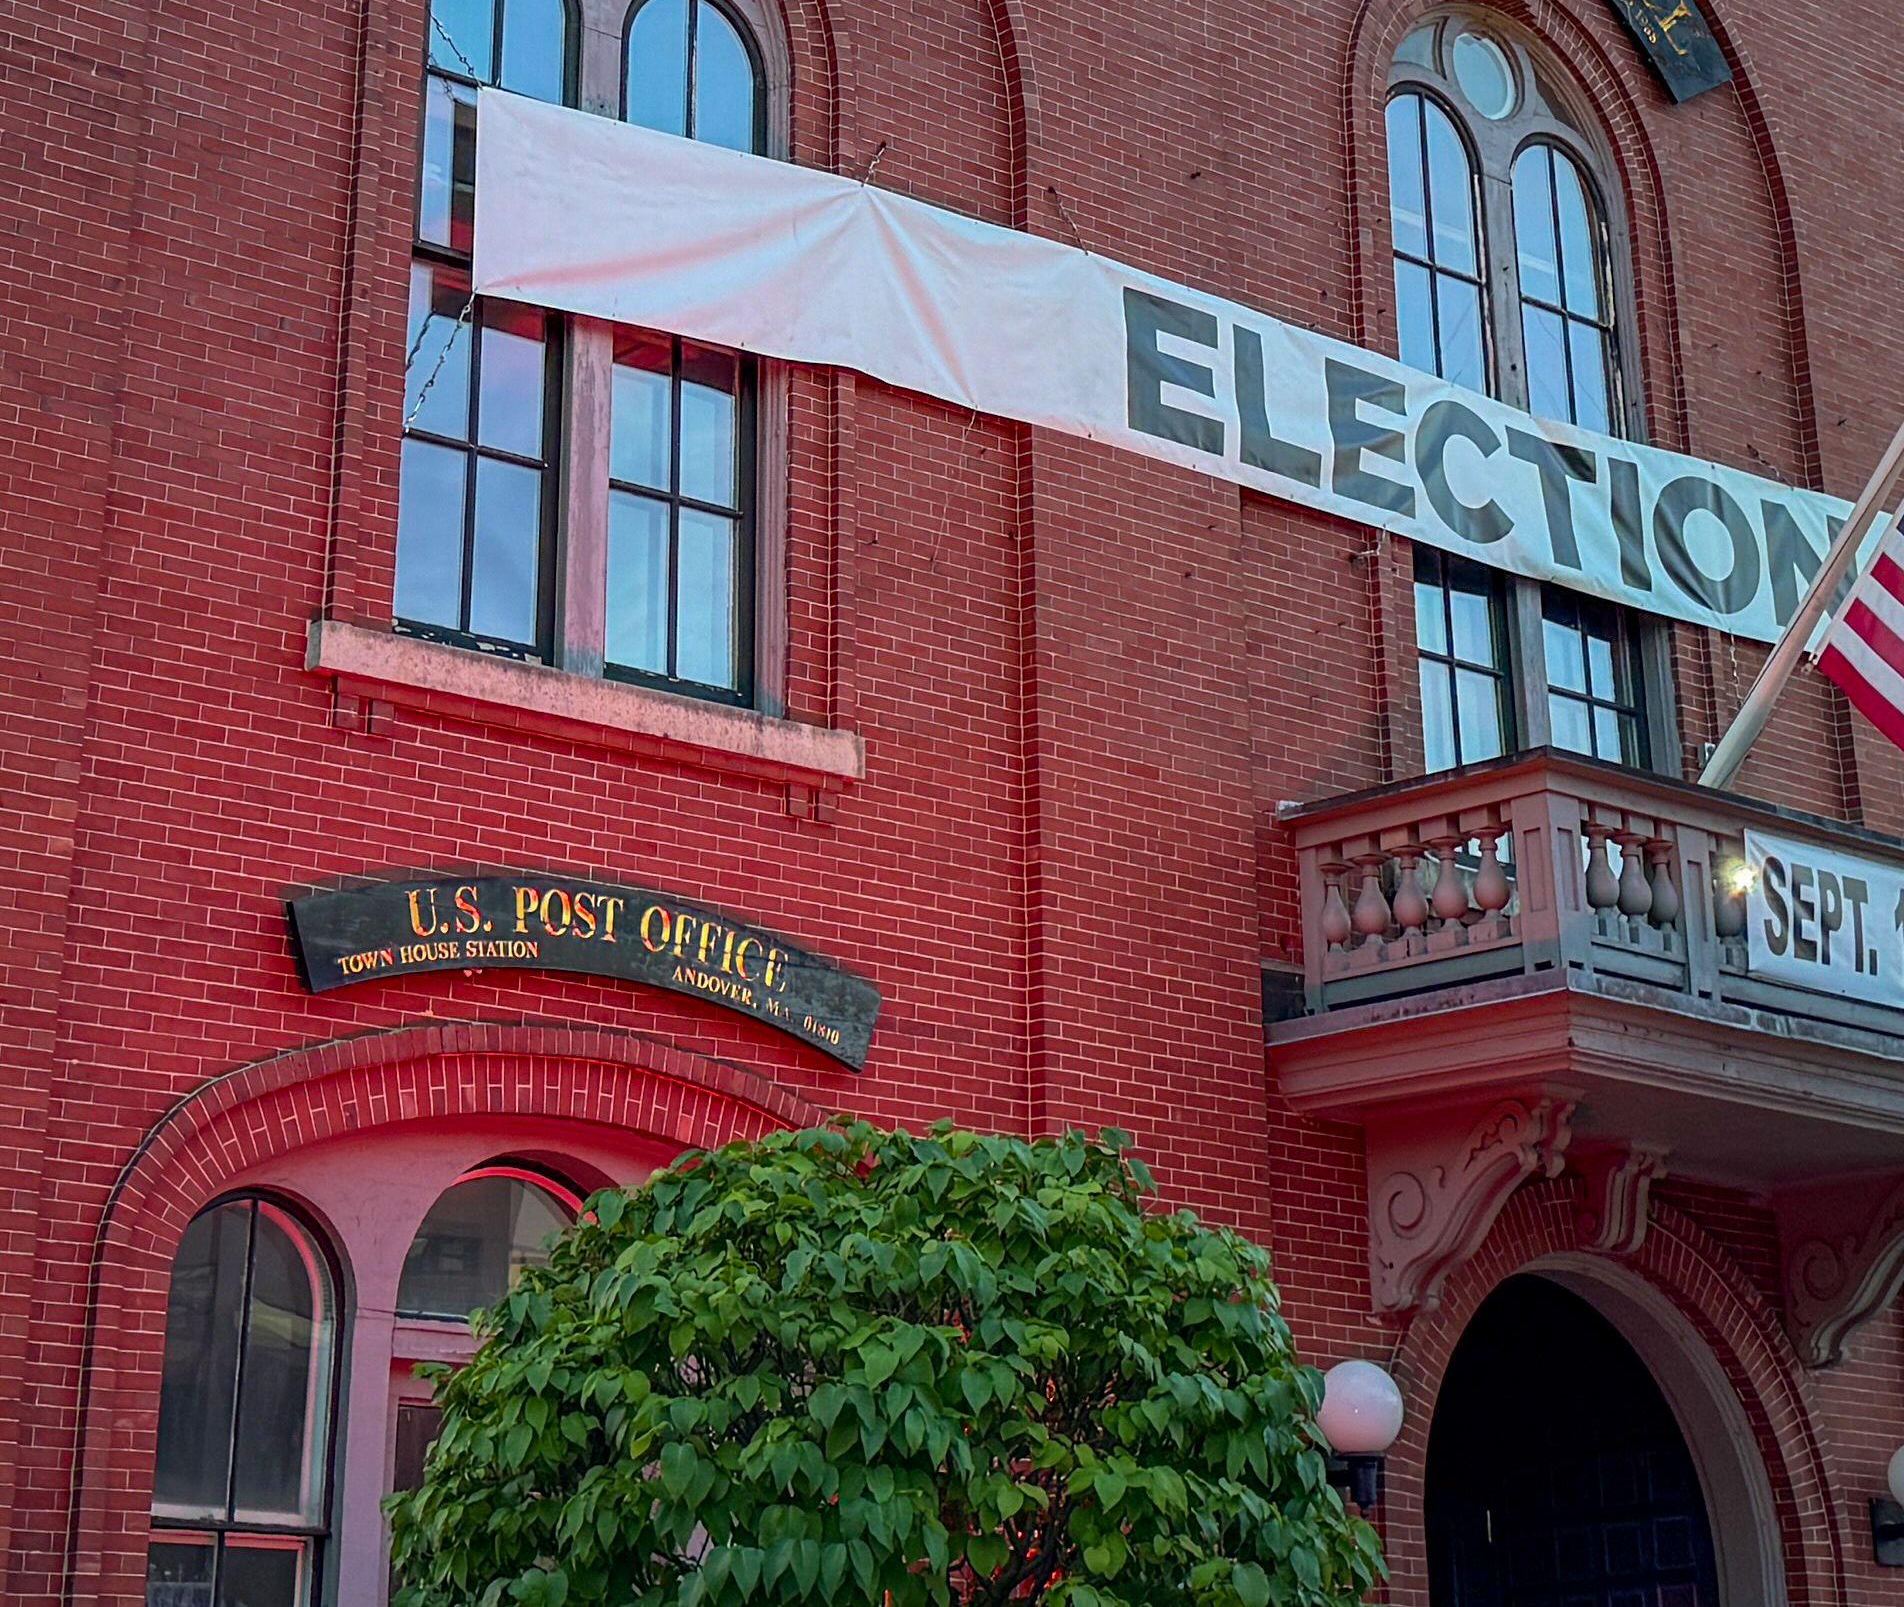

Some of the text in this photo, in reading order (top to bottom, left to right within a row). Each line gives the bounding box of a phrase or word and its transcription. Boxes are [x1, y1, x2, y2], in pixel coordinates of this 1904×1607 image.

[1121, 285, 1860, 628] ELECTION
[337, 940, 538, 975] TOWN HOUSE STATION
[404, 886, 789, 993] U.S. POST OFFICE
[1762, 856, 1878, 977] SEPT.
[672, 965, 757, 1010] ANDOVER,
[803, 1014, 841, 1046] 01810
